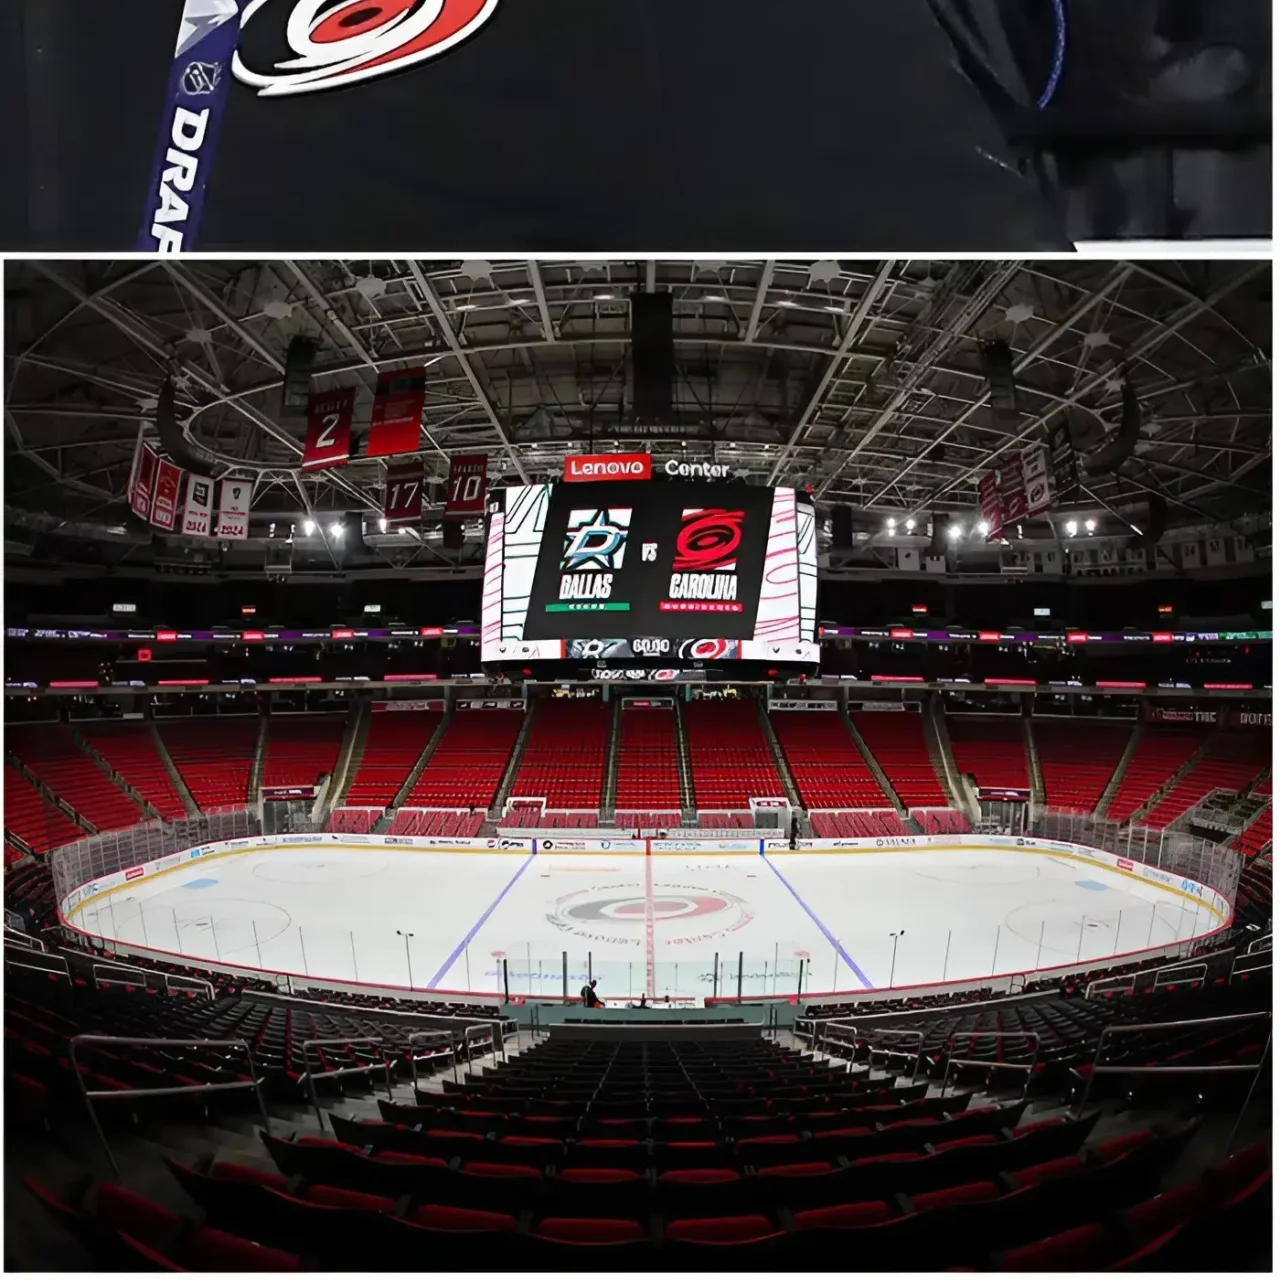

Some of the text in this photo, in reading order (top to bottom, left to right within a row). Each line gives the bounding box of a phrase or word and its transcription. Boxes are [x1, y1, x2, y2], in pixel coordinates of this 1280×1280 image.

[315, 413, 341, 448] 2
[570, 460, 645, 476] Lenovo
[389, 482, 420, 510] 17
[452, 475, 482, 502] 10
[558, 573, 614, 600] DALLAS
[668, 573, 739, 601] CAROLINA
